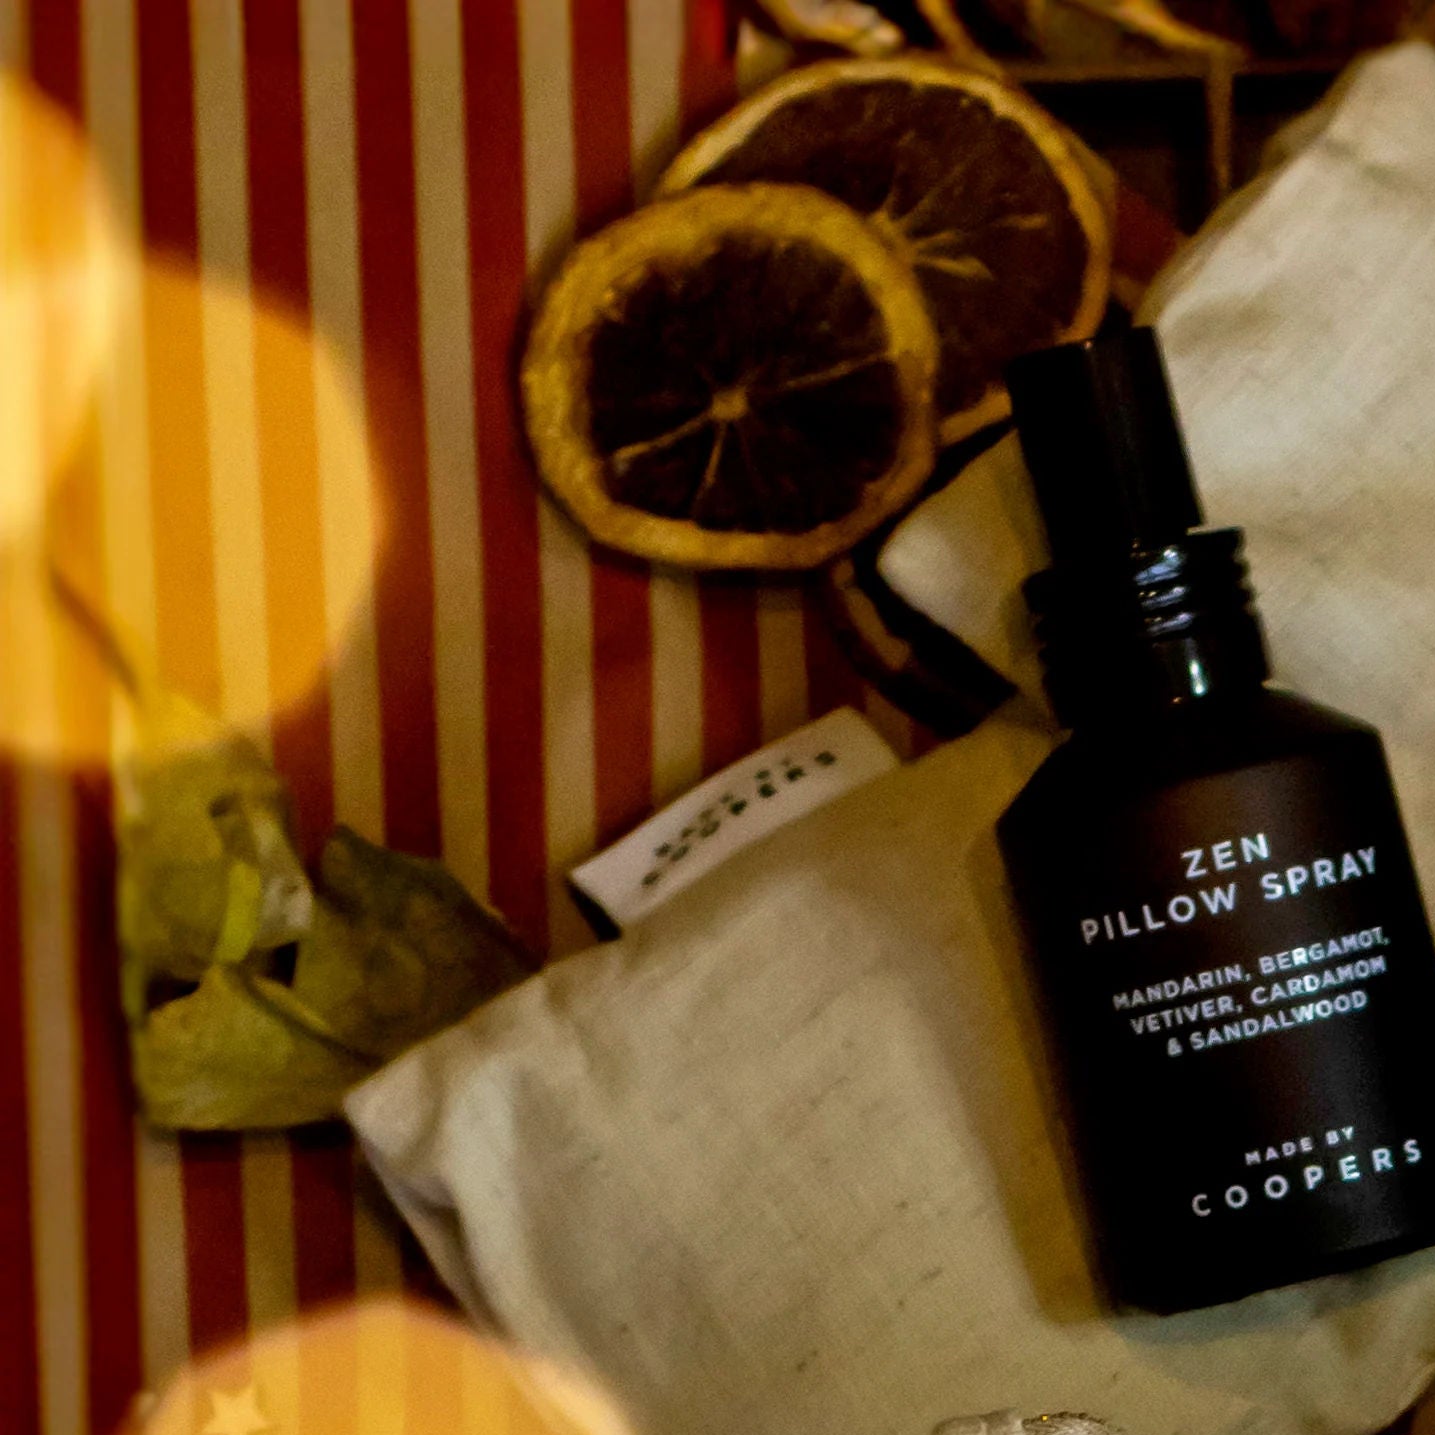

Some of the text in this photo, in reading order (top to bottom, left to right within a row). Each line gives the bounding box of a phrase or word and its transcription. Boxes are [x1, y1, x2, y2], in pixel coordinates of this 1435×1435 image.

[1182, 833, 1271, 878] ZEN
[1080, 847, 1378, 944] PILLOW SPRAY
[1113, 927, 1390, 1012] MANDARIN, BERGAMOT,
[1130, 956, 1387, 1036] VETIVER, CARDAMOM
[1166, 990, 1368, 1057] & SANDALWOOD
[1191, 1139, 1422, 1217] COOPERS
[1245, 1126, 1354, 1166] MADE BY
